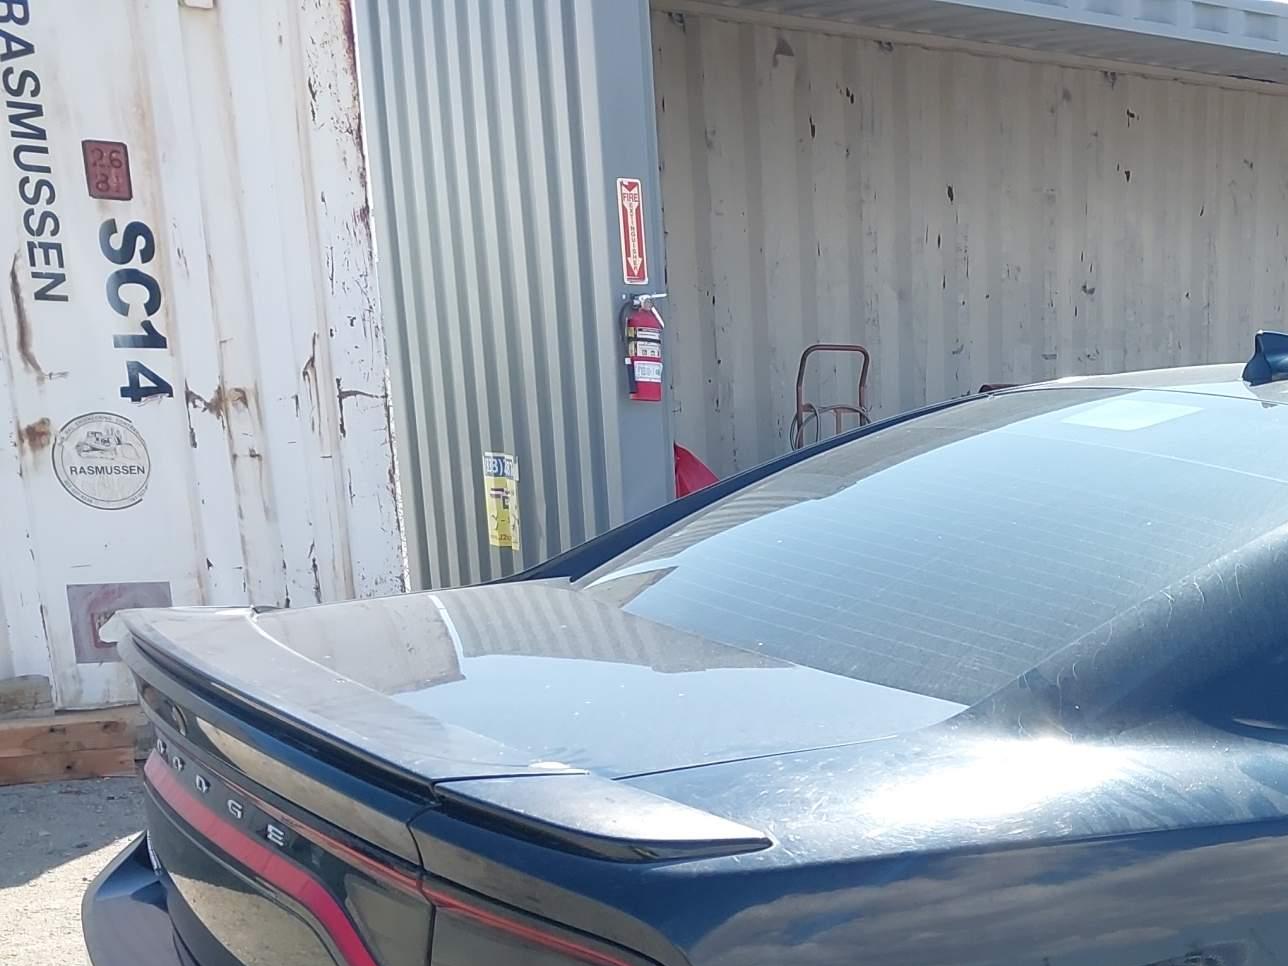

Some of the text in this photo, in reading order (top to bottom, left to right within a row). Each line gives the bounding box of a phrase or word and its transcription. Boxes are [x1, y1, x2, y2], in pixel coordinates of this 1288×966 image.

[0, 0, 69, 302] RASMUSSEN
[622, 192, 640, 202] FIRE
[629, 202, 639, 271] EXTINGUISHER
[99, 218, 174, 402] SC14
[69, 465, 146, 476] RASMUSSEN
[157, 738, 285, 847] DODGE
